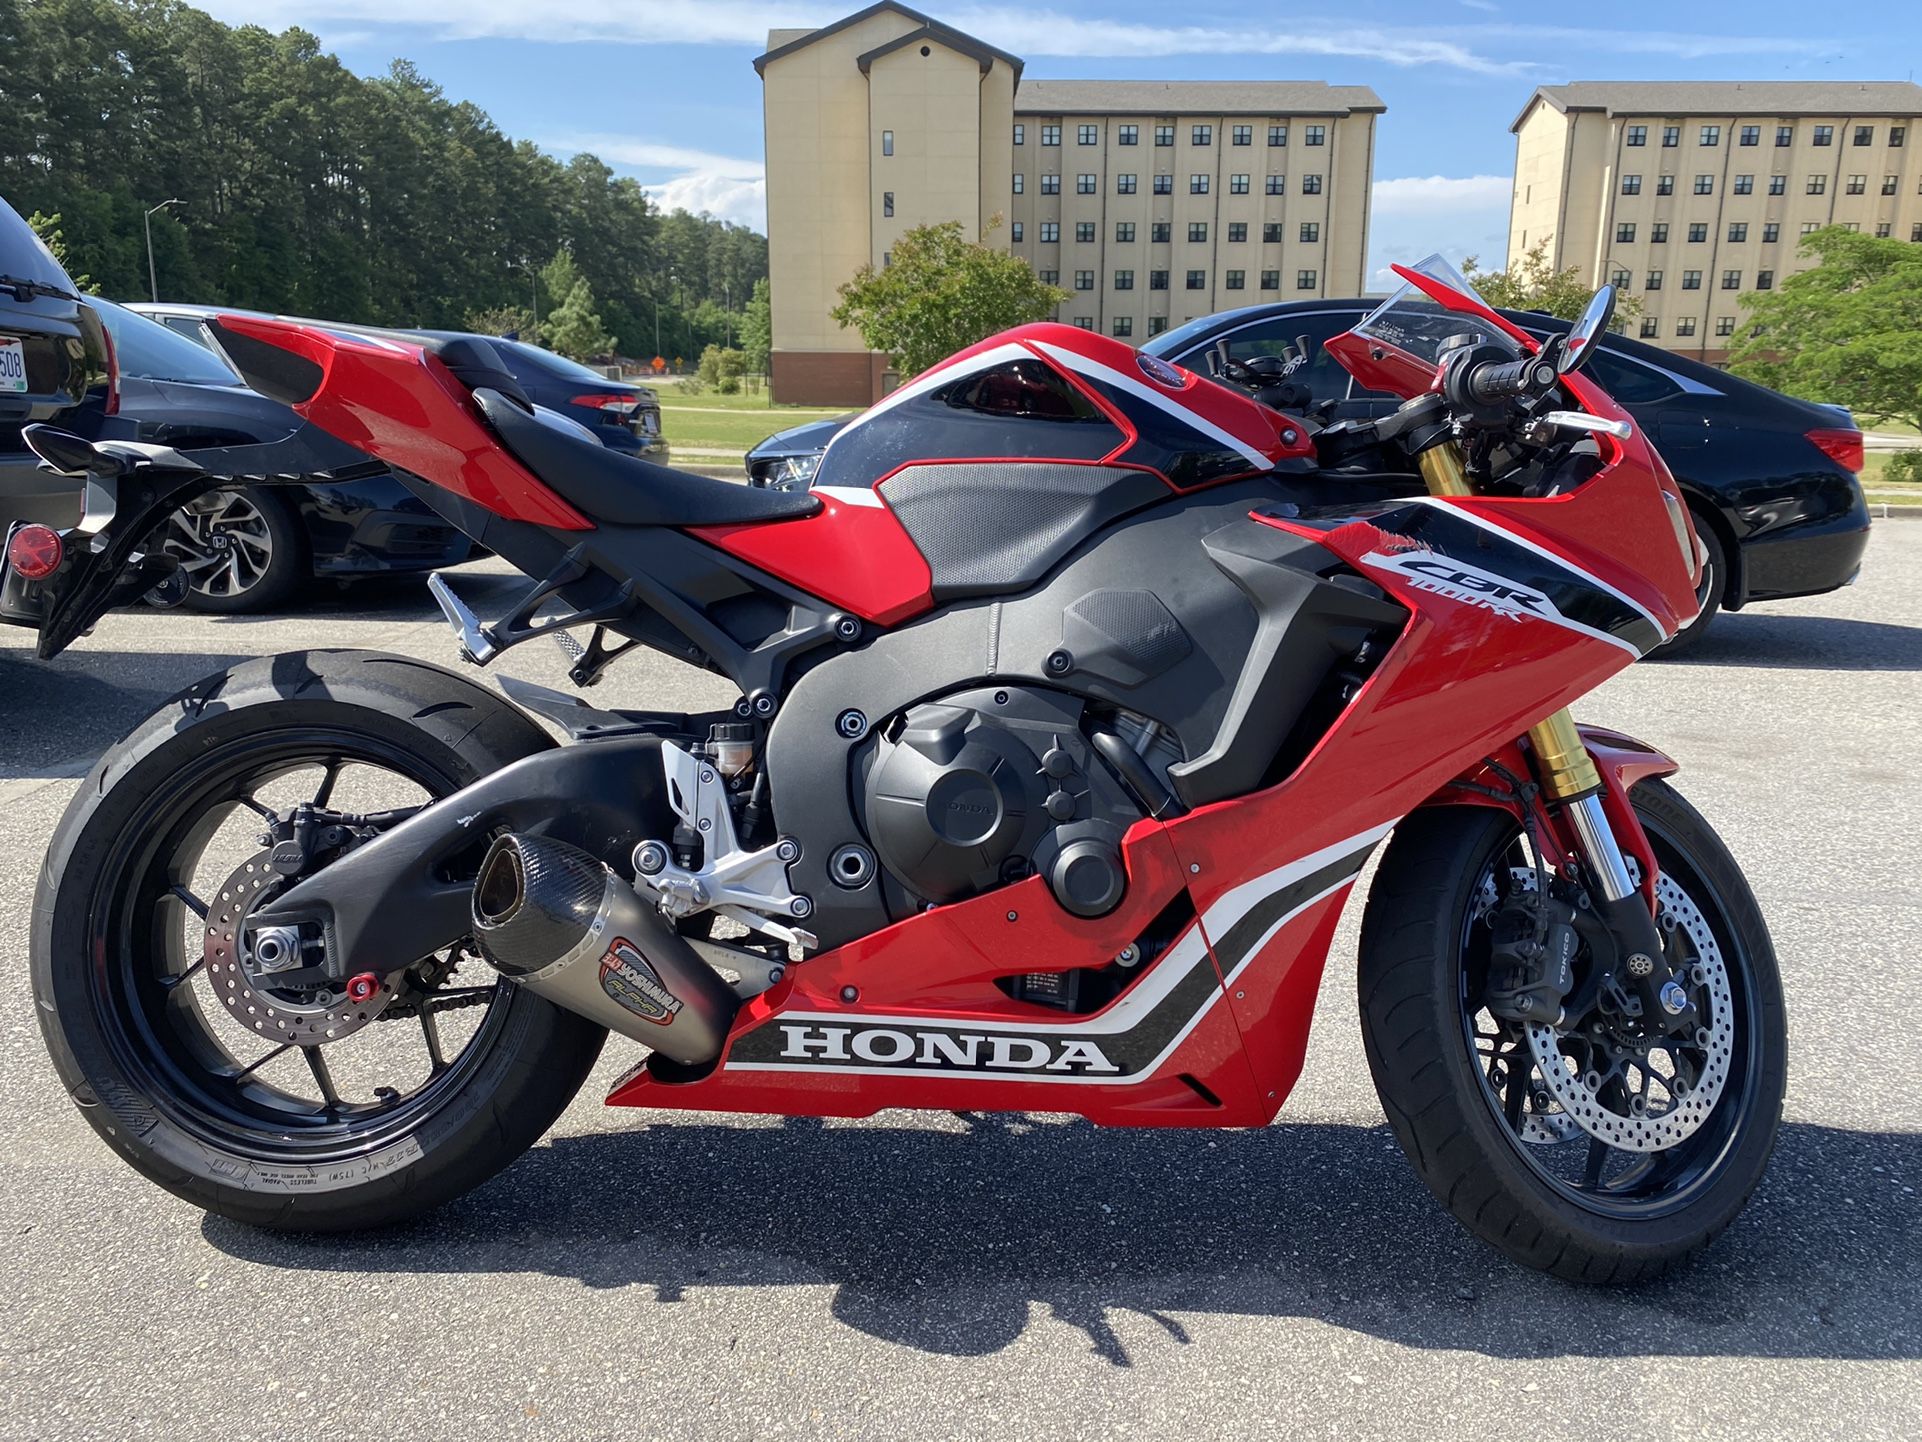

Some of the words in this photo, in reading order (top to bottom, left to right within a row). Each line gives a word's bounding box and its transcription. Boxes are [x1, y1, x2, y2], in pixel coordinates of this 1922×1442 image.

[1399, 561, 1548, 616] CBR
[1559, 932, 1570, 985] TOKICO
[607, 979, 659, 1015] ALPHA
[616, 962, 681, 1014] YOSHIMURA
[779, 1024, 1120, 1072] HONDA
